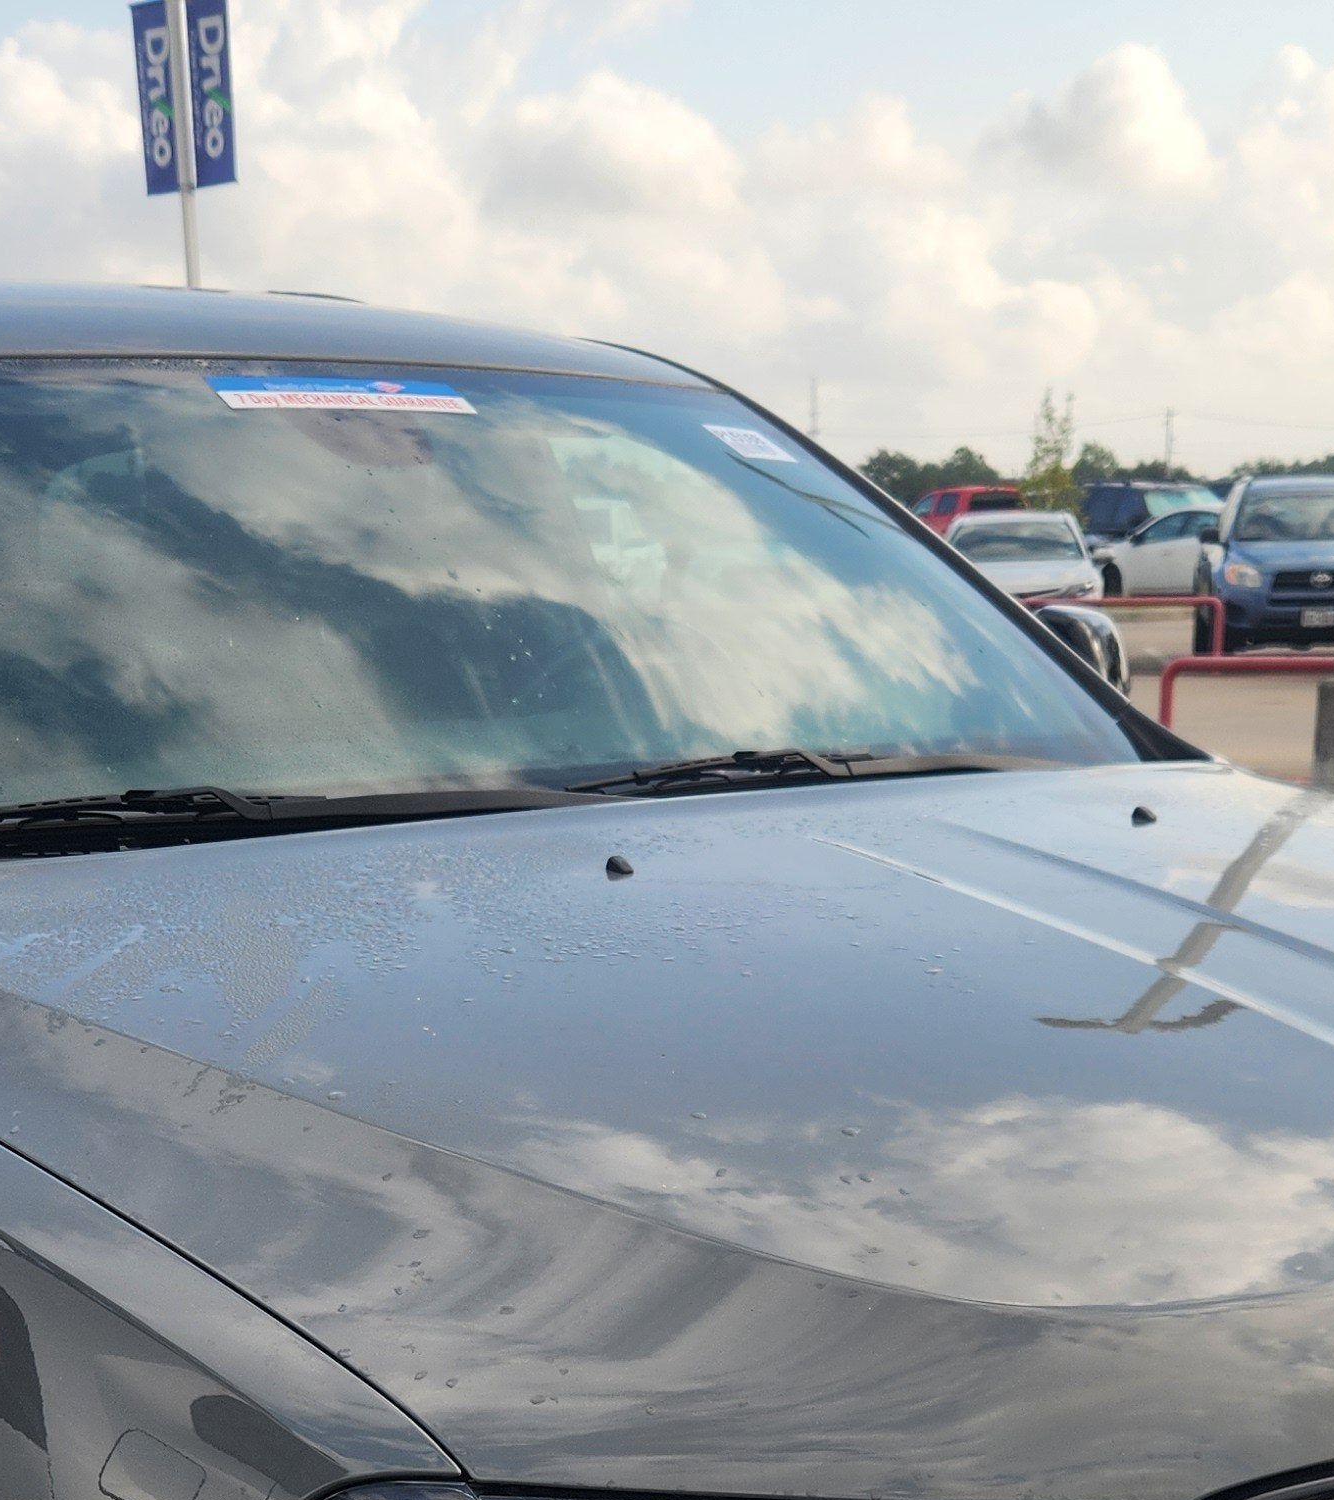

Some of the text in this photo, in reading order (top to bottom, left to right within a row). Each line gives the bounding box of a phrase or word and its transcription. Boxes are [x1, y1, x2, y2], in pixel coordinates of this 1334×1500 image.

[248, 393, 280, 408] Day
[280, 393, 378, 407] MECHANICAL
[377, 395, 462, 410] GUARANTEE
